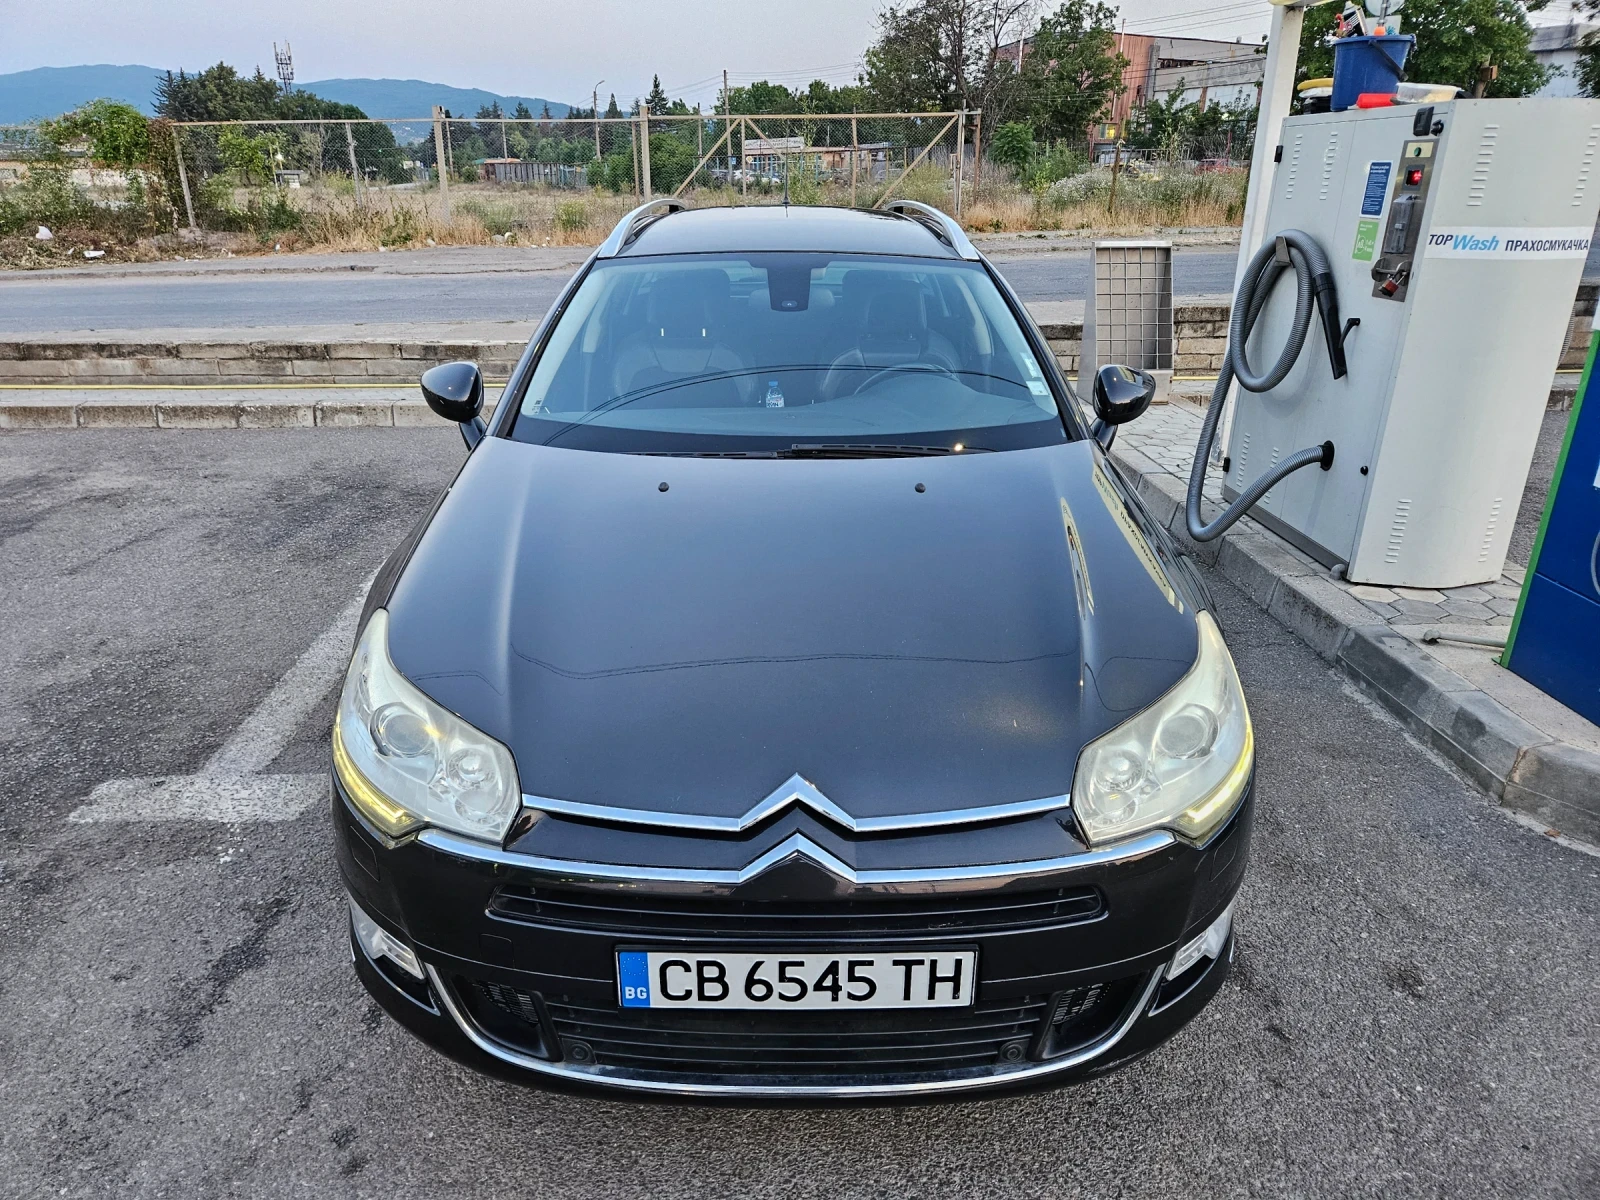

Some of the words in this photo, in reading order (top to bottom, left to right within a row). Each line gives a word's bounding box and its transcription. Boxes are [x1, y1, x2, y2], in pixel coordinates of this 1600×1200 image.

[1505, 239, 1589, 251] ПРАХОСМУКАЧКА
[659, 959, 730, 1001] CB
[744, 960, 877, 1002] 6545
[892, 958, 963, 1001] TH
[624, 986, 648, 999] BG
